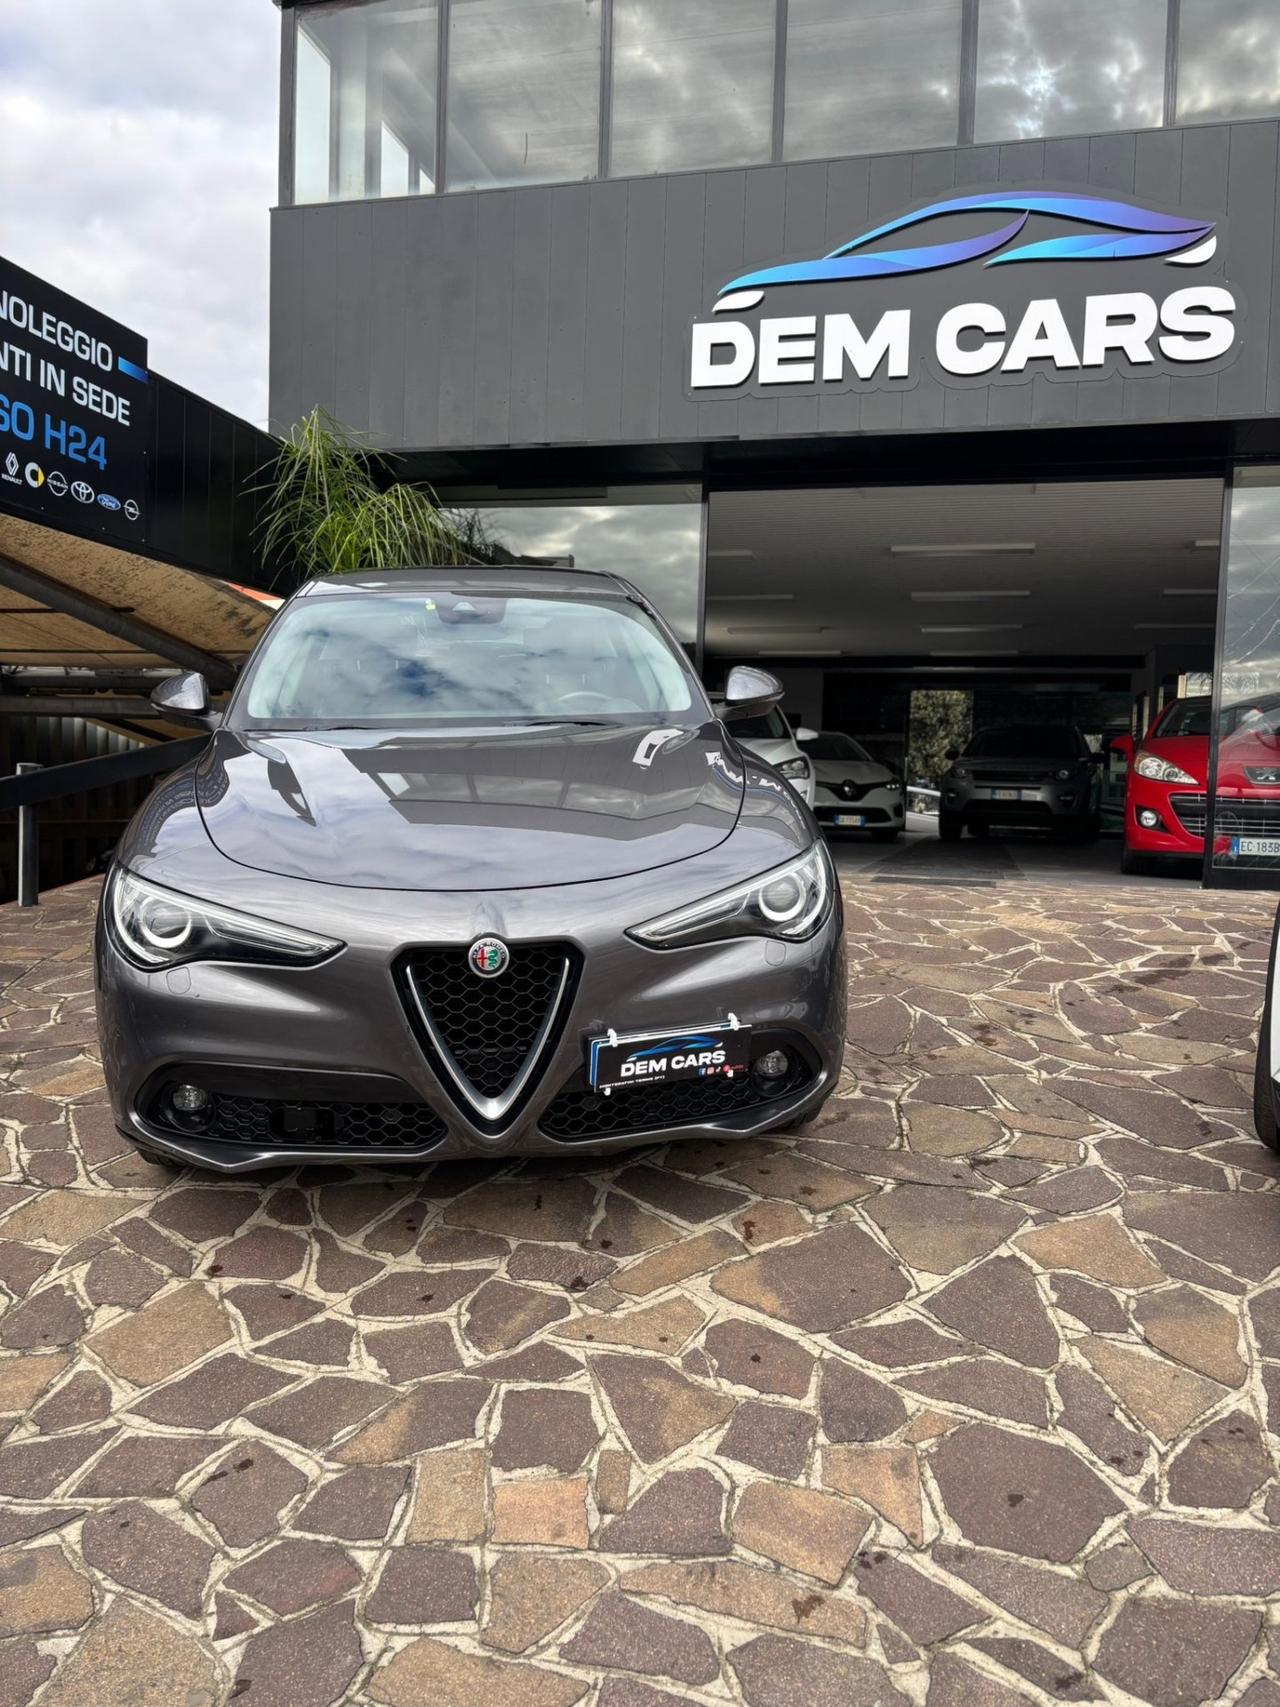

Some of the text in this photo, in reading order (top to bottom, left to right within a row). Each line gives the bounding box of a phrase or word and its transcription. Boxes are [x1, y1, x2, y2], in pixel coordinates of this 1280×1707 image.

[691, 286, 1236, 389] DEM CARS
[40, 358, 65, 398] IN
[72, 376, 130, 427] SEDE
[45, 413, 107, 471] H24
[620, 1057, 667, 1078] DEM
[671, 1050, 726, 1070] CARS
